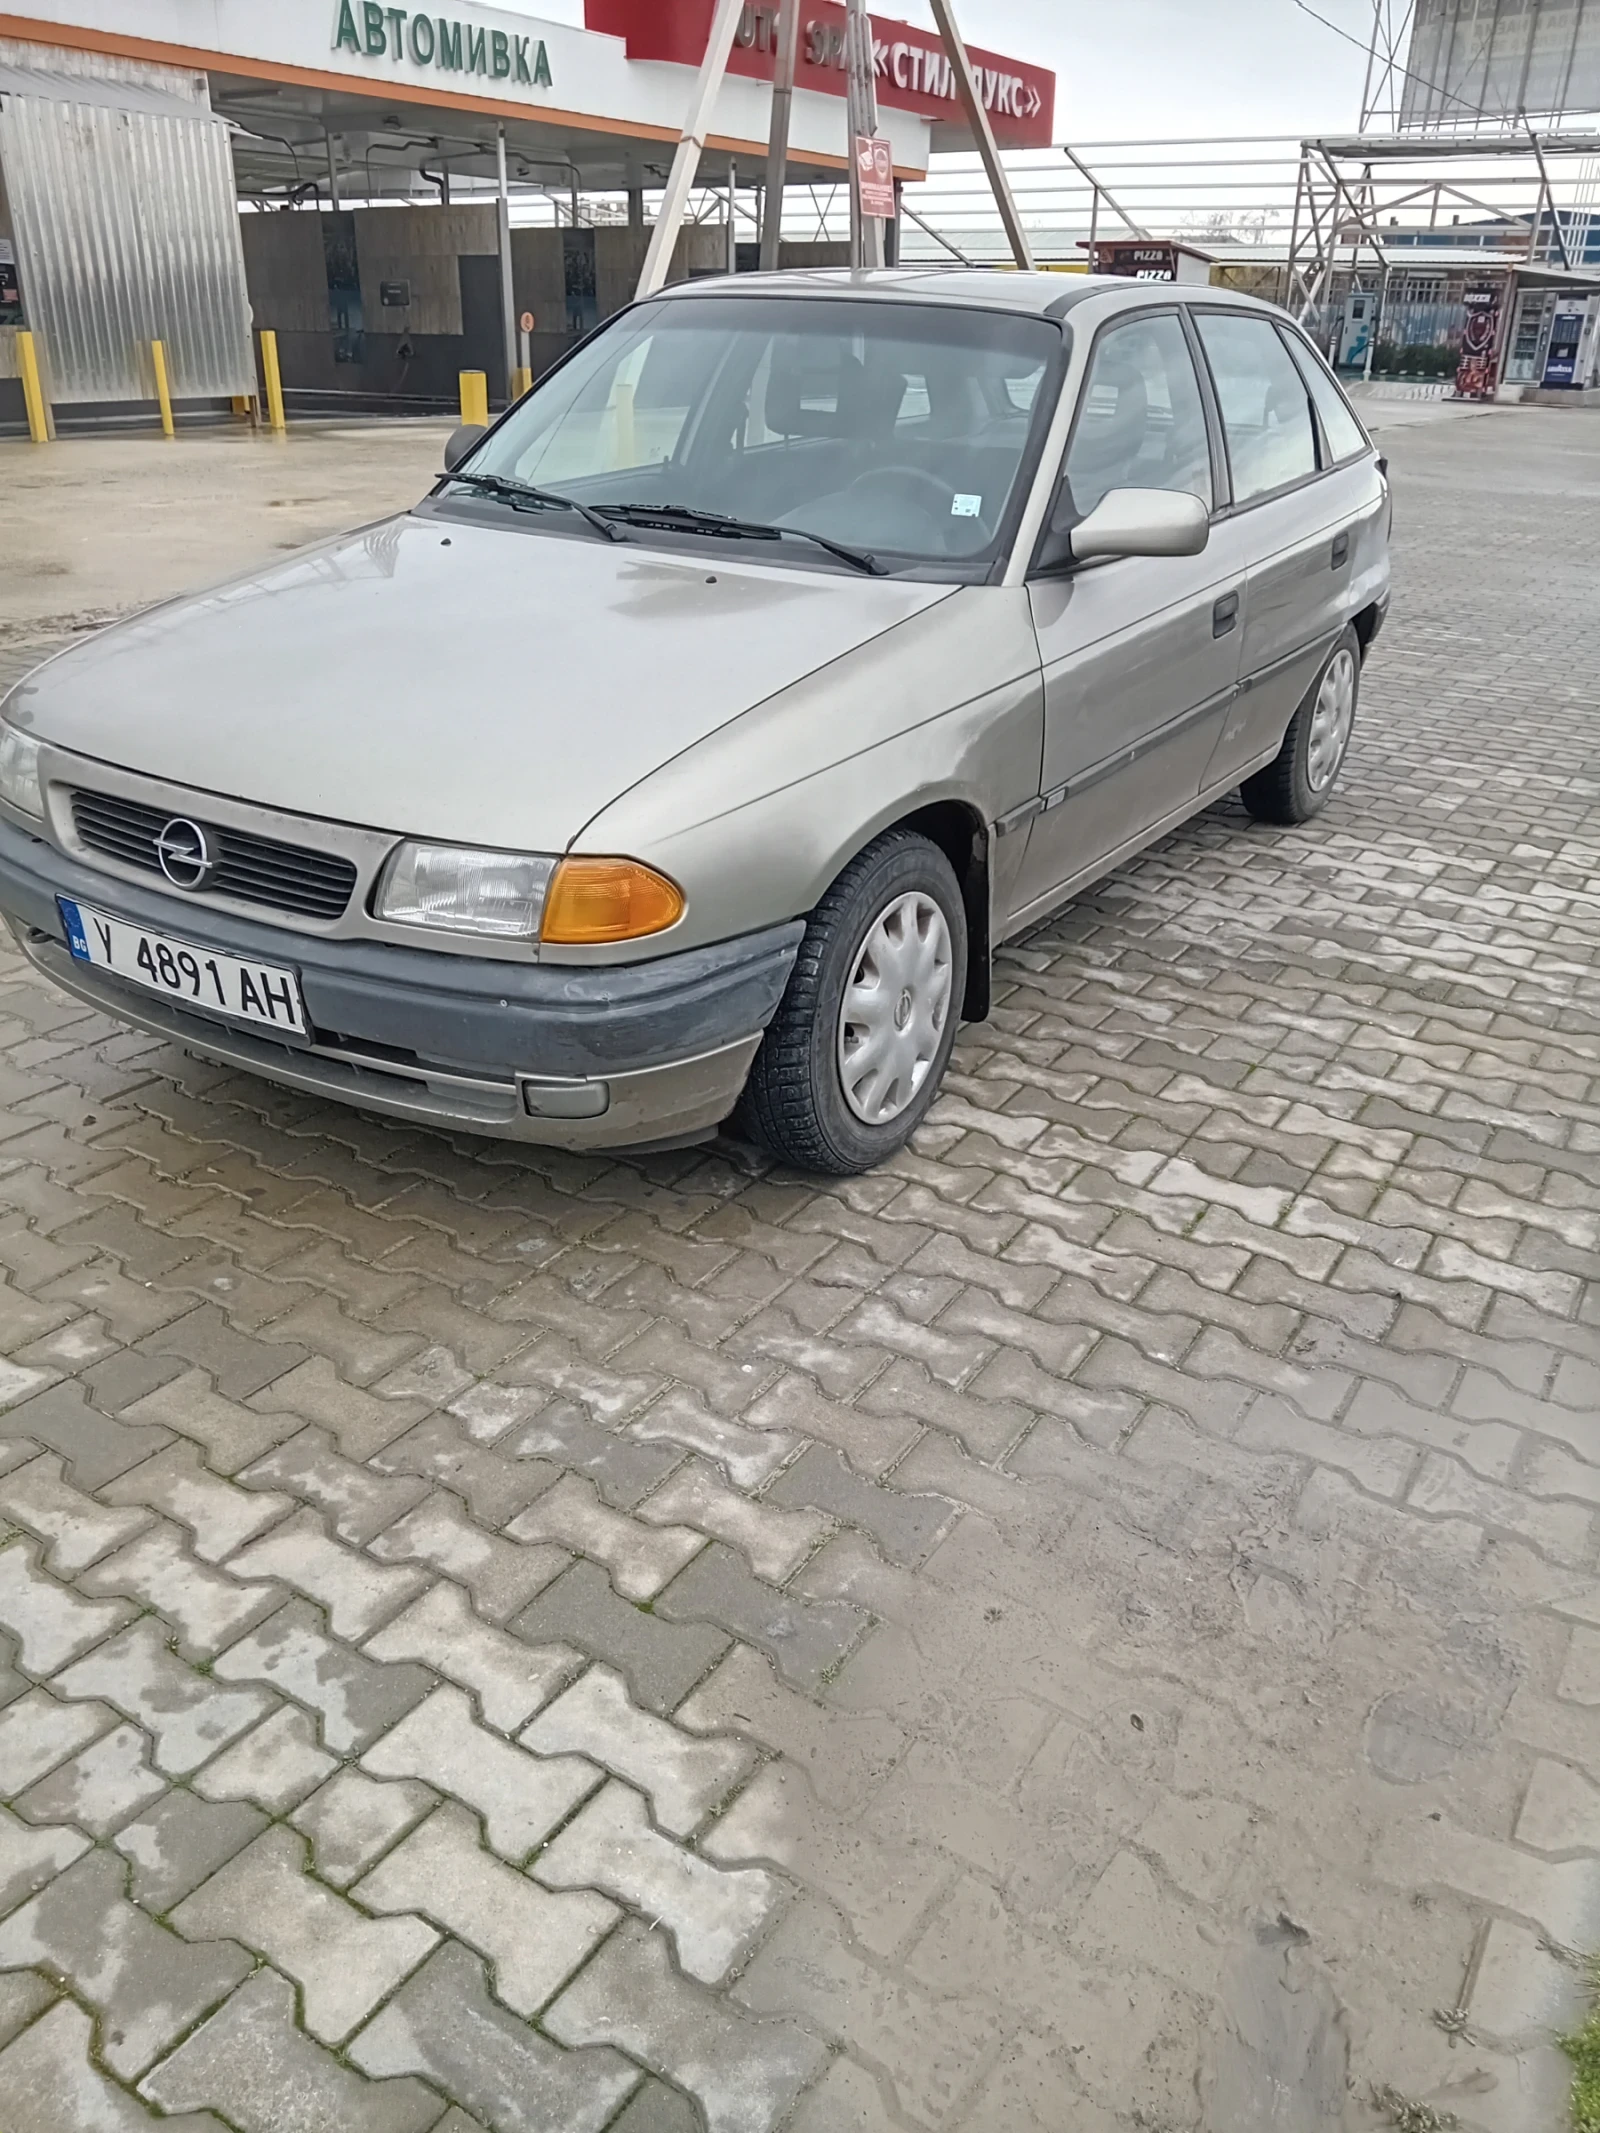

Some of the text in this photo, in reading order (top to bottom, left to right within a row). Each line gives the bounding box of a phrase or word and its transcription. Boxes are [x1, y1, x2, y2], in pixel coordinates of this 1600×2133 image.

[331, 0, 553, 87] АВТОМИВКА
[1134, 250, 1163, 260] PIZZA
[72, 935, 88, 953] BG
[93, 917, 296, 1025] Y 4891 AH
